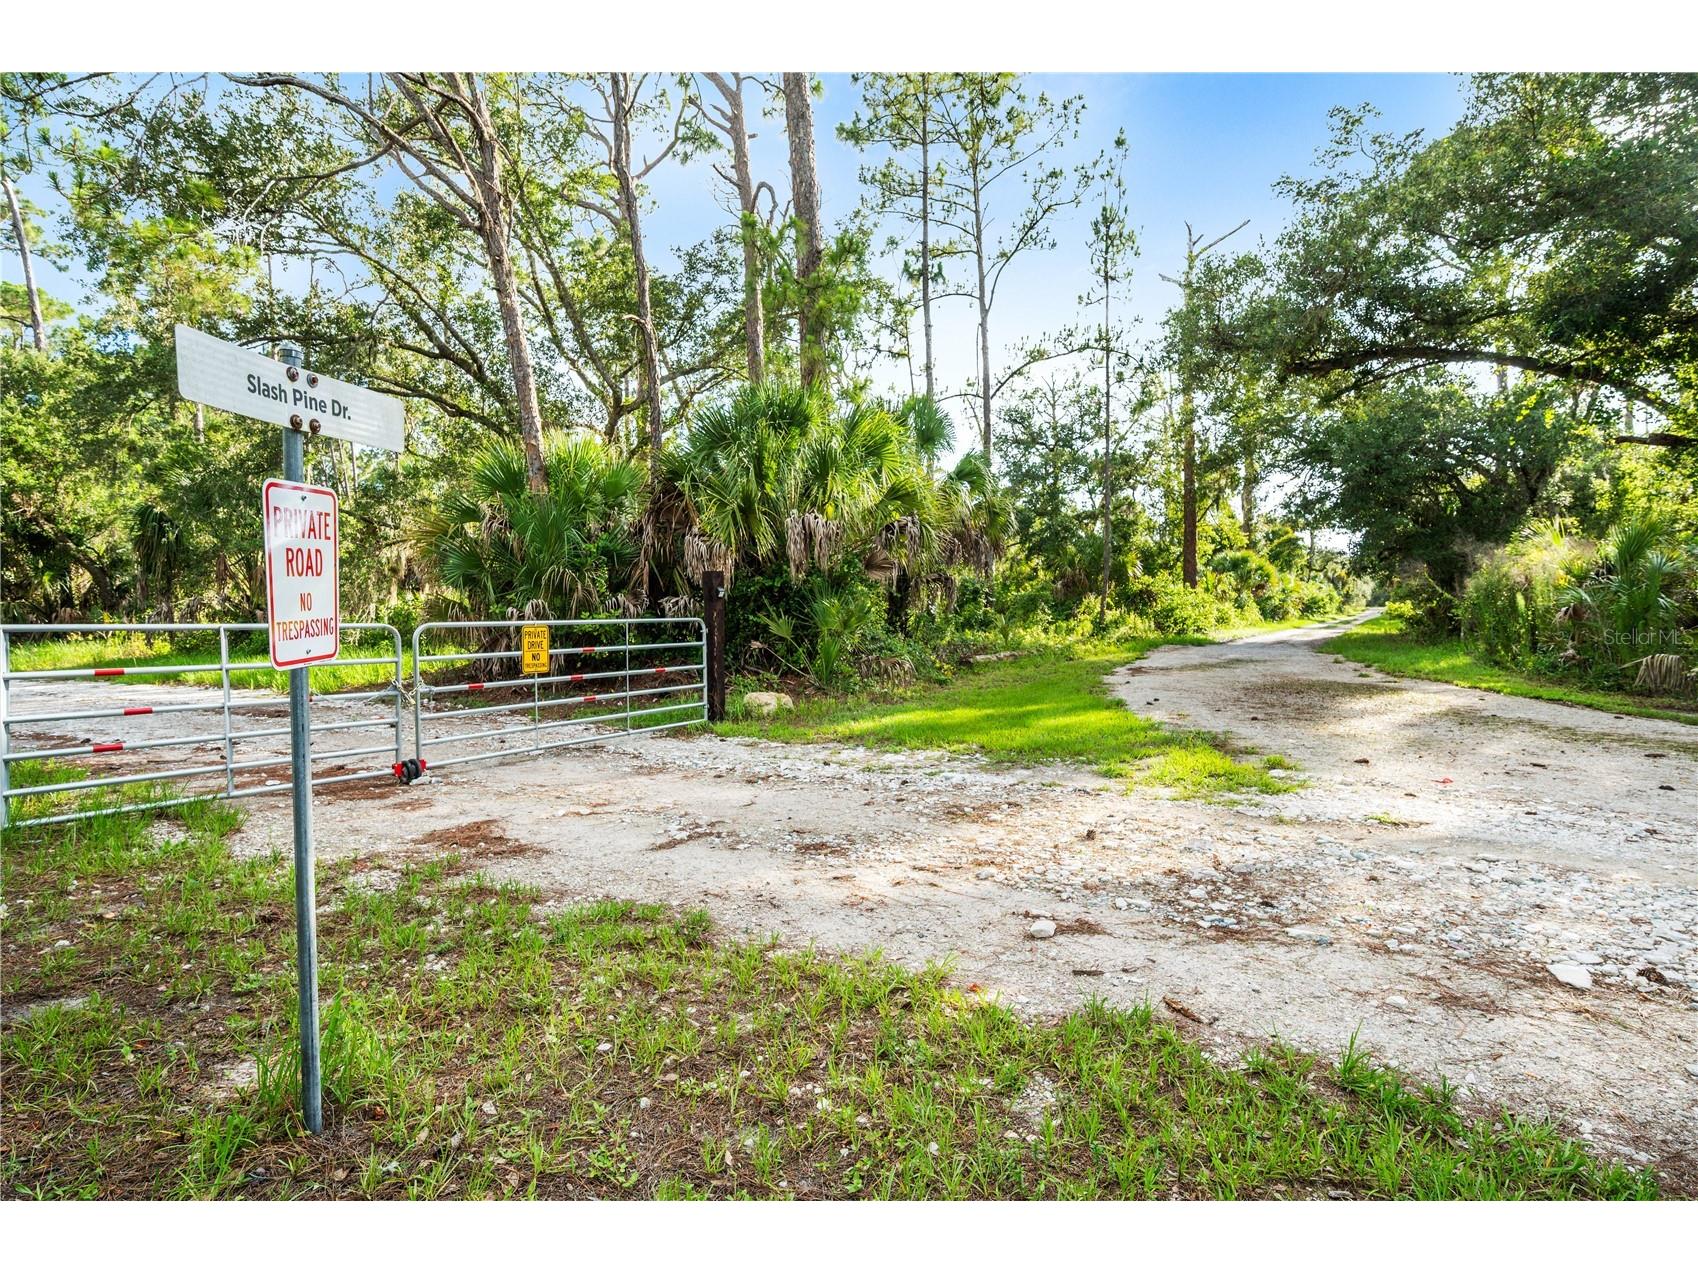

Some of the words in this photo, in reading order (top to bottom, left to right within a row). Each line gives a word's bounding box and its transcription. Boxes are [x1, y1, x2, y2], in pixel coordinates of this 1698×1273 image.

[247, 373, 288, 404] Slash
[293, 388, 327, 413] Pine
[331, 399, 351, 420] Dr.
[273, 506, 331, 540] PRIVATE
[285, 547, 323, 577] ROAD
[300, 592, 312, 612] NO
[276, 617, 334, 642] TRESPASSING
[525, 631, 547, 639] PRIVATE
[528, 641, 544, 650] DRIVE
[532, 653, 541, 661] NO
